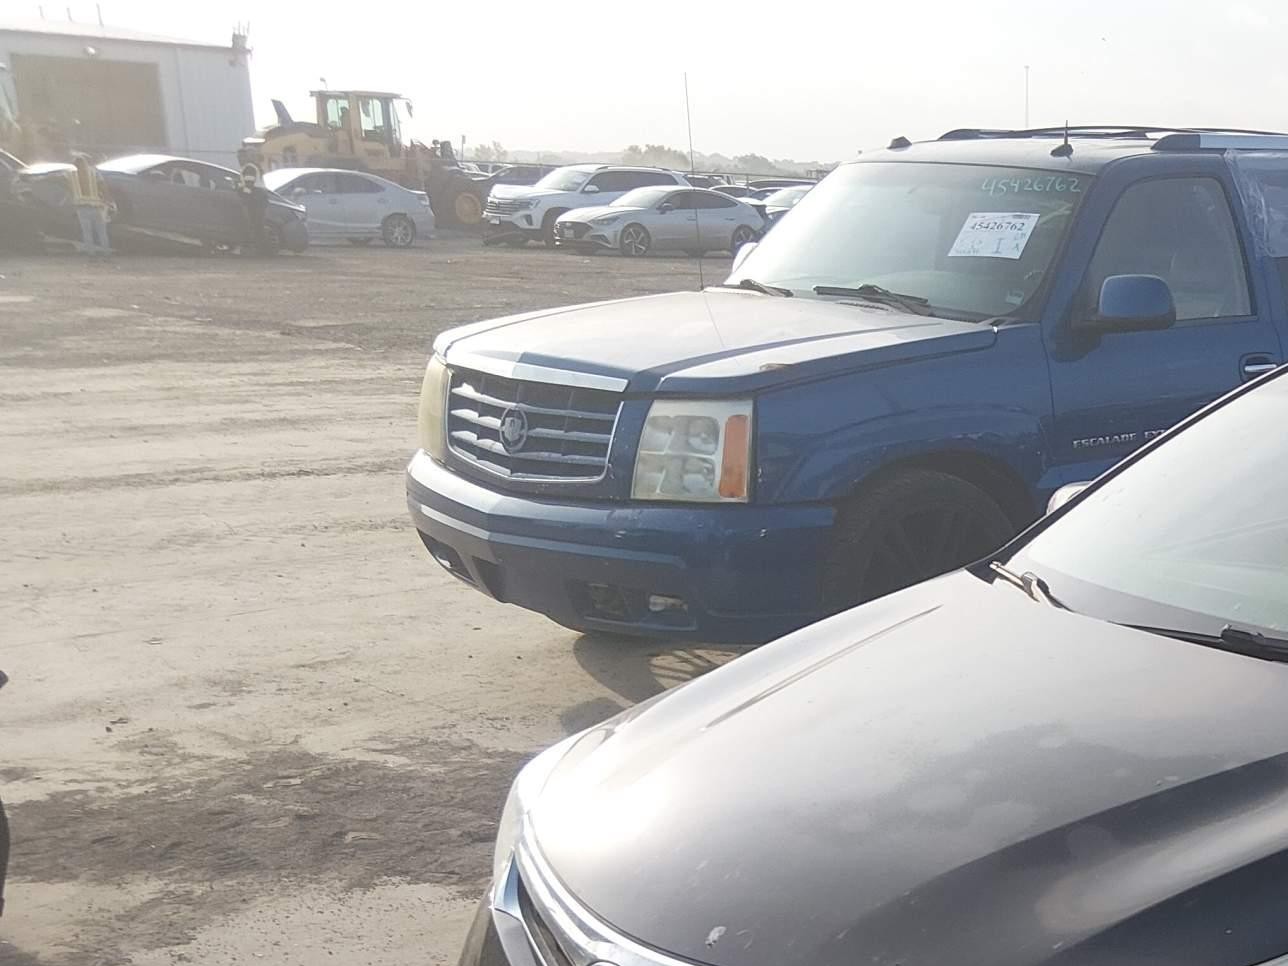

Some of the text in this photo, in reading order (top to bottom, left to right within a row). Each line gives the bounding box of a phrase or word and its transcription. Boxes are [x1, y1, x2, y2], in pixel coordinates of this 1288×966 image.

[980, 176, 1082, 196] 45426762
[971, 221, 1026, 232] 45426762
[1073, 432, 1137, 448] ESCALADE
